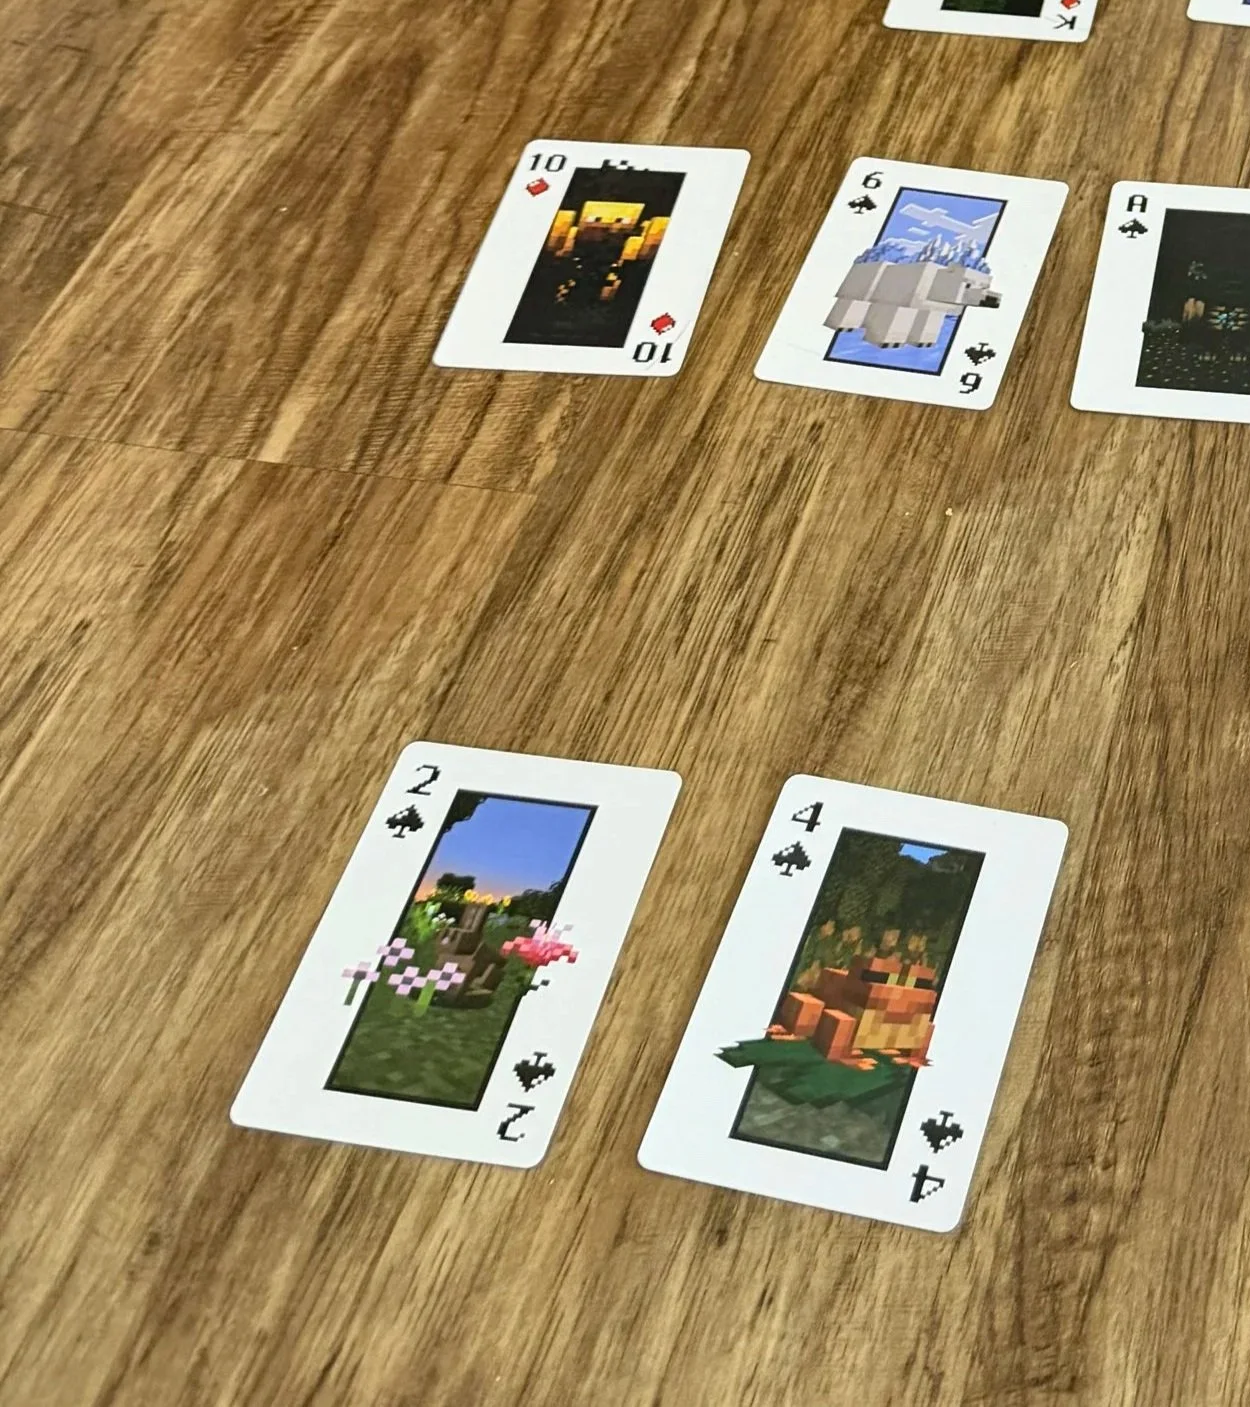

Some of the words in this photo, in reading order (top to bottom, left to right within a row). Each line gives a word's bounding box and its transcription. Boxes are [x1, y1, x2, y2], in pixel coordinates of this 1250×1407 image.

[1053, 14, 1077, 30] K
[529, 153, 567, 172] 10
[862, 171, 884, 190] 6
[1126, 194, 1148, 213] A
[632, 341, 673, 364] 10
[959, 372, 983, 395] 6
[406, 764, 441, 797] 2
[791, 801, 824, 833] 4
[497, 1103, 535, 1143] 2
[909, 1164, 946, 1204] 4
